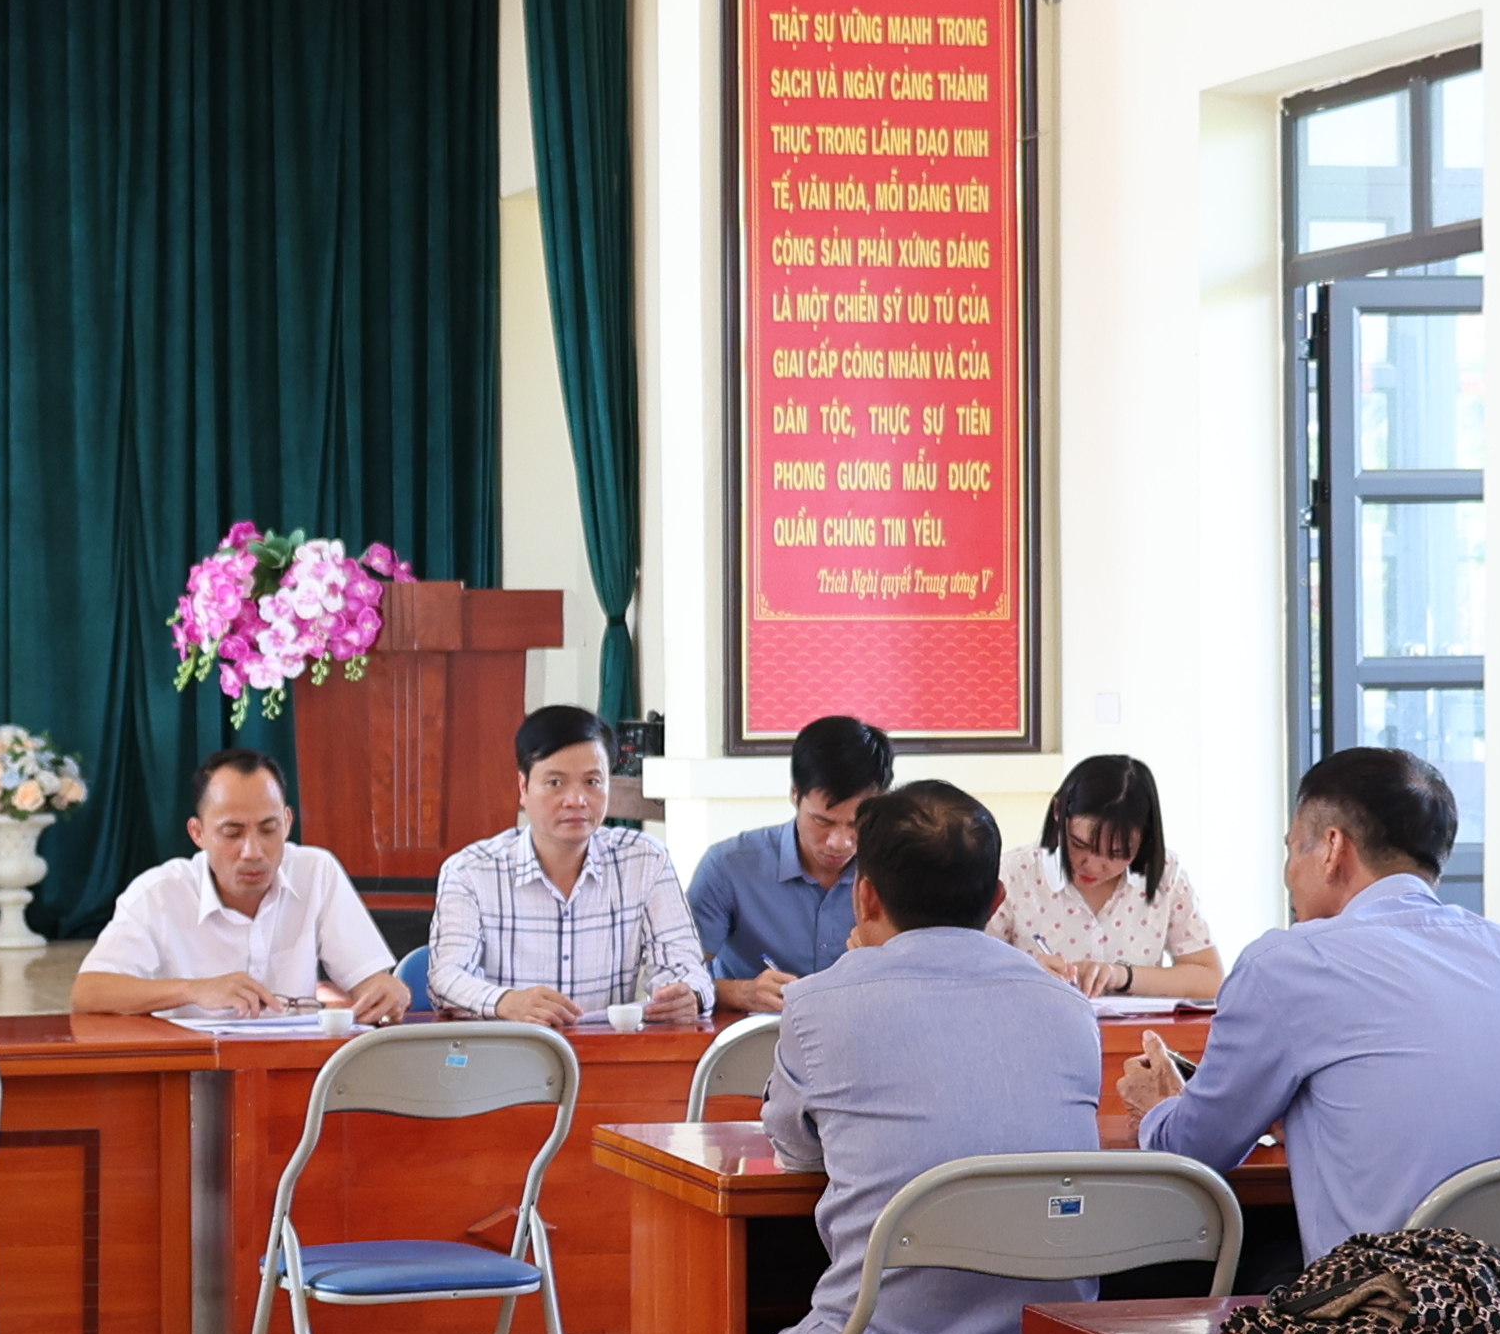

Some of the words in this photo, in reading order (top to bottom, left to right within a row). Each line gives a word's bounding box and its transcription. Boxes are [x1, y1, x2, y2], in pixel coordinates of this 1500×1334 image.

[769, 5, 809, 50] THẬT
[813, 11, 835, 51] SỰ
[839, 7, 883, 44] VỮNG
[887, 15, 932, 53] MẠNH
[936, 16, 988, 47] TRONG
[770, 68, 812, 105] SẠCH
[815, 62, 838, 98] VÀ
[842, 63, 886, 99] NGÀY
[889, 64, 934, 101] CÀNG
[936, 65, 988, 101] THÀNH
[770, 124, 812, 162] THỤC
[815, 125, 867, 155] TRONG
[871, 119, 912, 155] LÃNH
[915, 127, 949, 164] ĐẠO
[953, 128, 989, 157] KINH
[770, 168, 794, 213] TẾ,
[797, 173, 831, 210] VĂN
[834, 174, 871, 215] HÓA,
[874, 168, 904, 211] MỖI
[907, 171, 951, 213] ĐẢNG
[954, 176, 989, 213] VIÊN
[771, 229, 815, 275] CỘNG
[820, 226, 852, 267] SẢN
[857, 226, 892, 267] PHẢI
[897, 231, 941, 268] XỨNG
[945, 232, 990, 269] ĐÁNG
[772, 285, 792, 322] LÀ
[796, 285, 830, 331] MỘT
[833, 279, 878, 323] CHIỄN
[882, 286, 903, 323] SỸ
[907, 291, 929, 323] ƯU
[933, 288, 954, 324] TÚ
[957, 284, 990, 324] CỦA
[773, 505, 818, 547] QUẦN
[822, 509, 877, 547] CHÚNG
[880, 516, 907, 547] TIN
[911, 510, 946, 547] YÊU.
[914, 568, 948, 600] Trung
